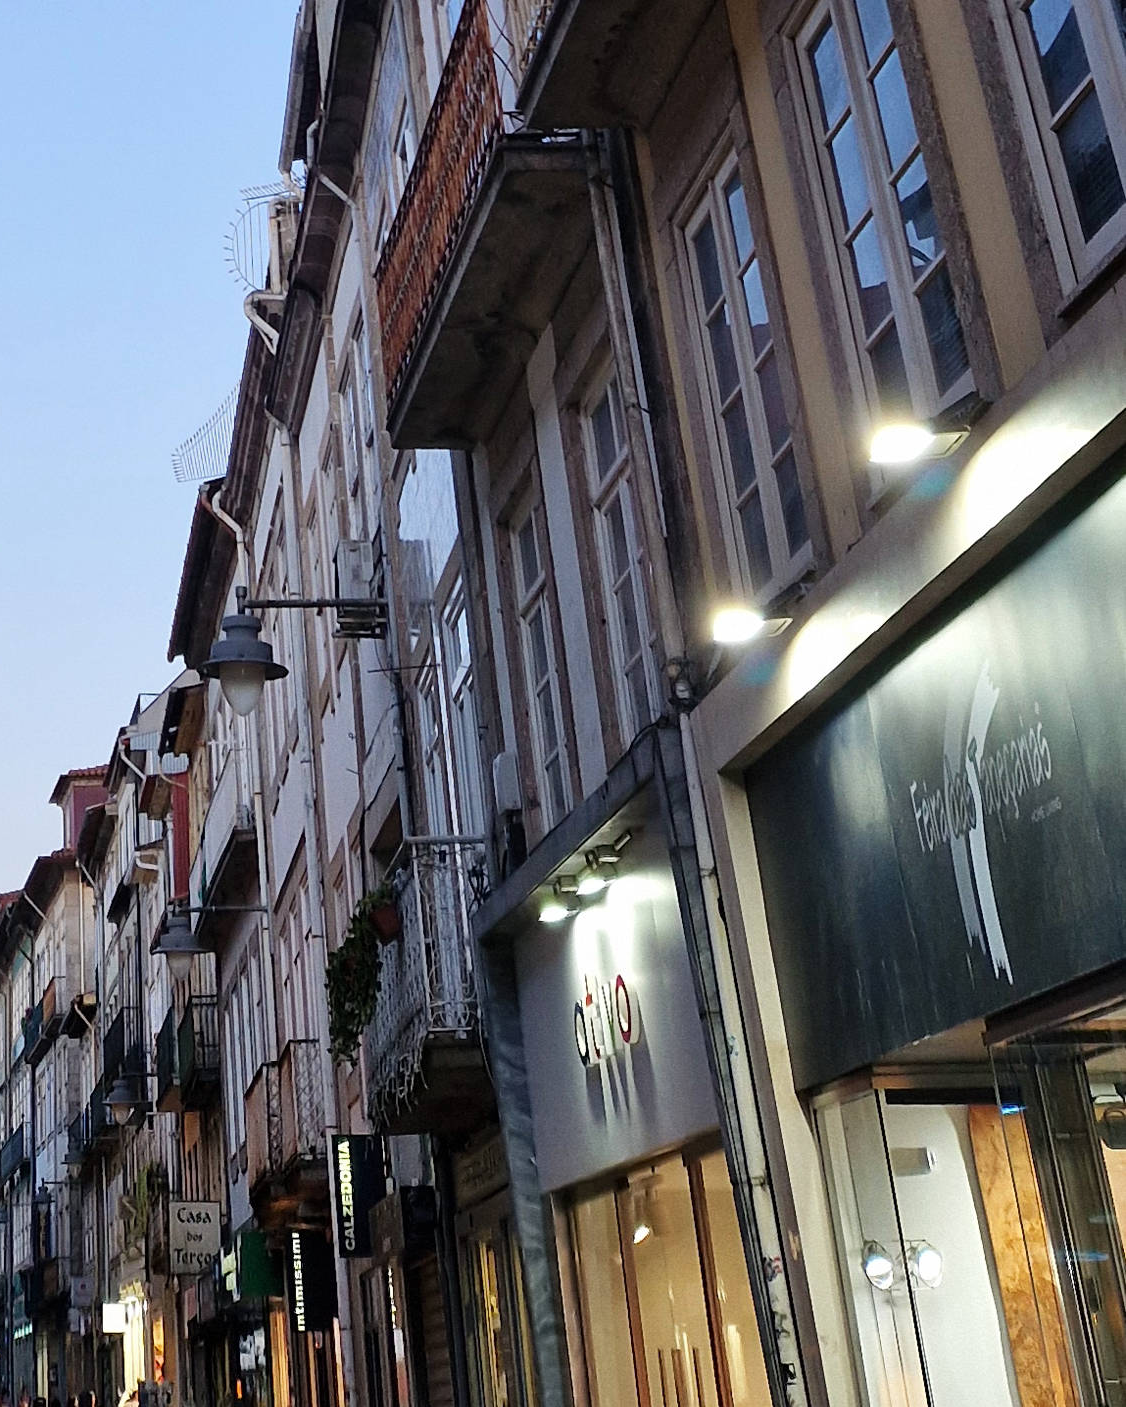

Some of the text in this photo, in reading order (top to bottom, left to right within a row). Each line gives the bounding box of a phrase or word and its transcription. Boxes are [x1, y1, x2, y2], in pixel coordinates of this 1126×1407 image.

[176, 1206, 212, 1223] Casa
[336, 1137, 356, 1251] CALZEDONIA
[291, 1232, 306, 1331] intimissimi
